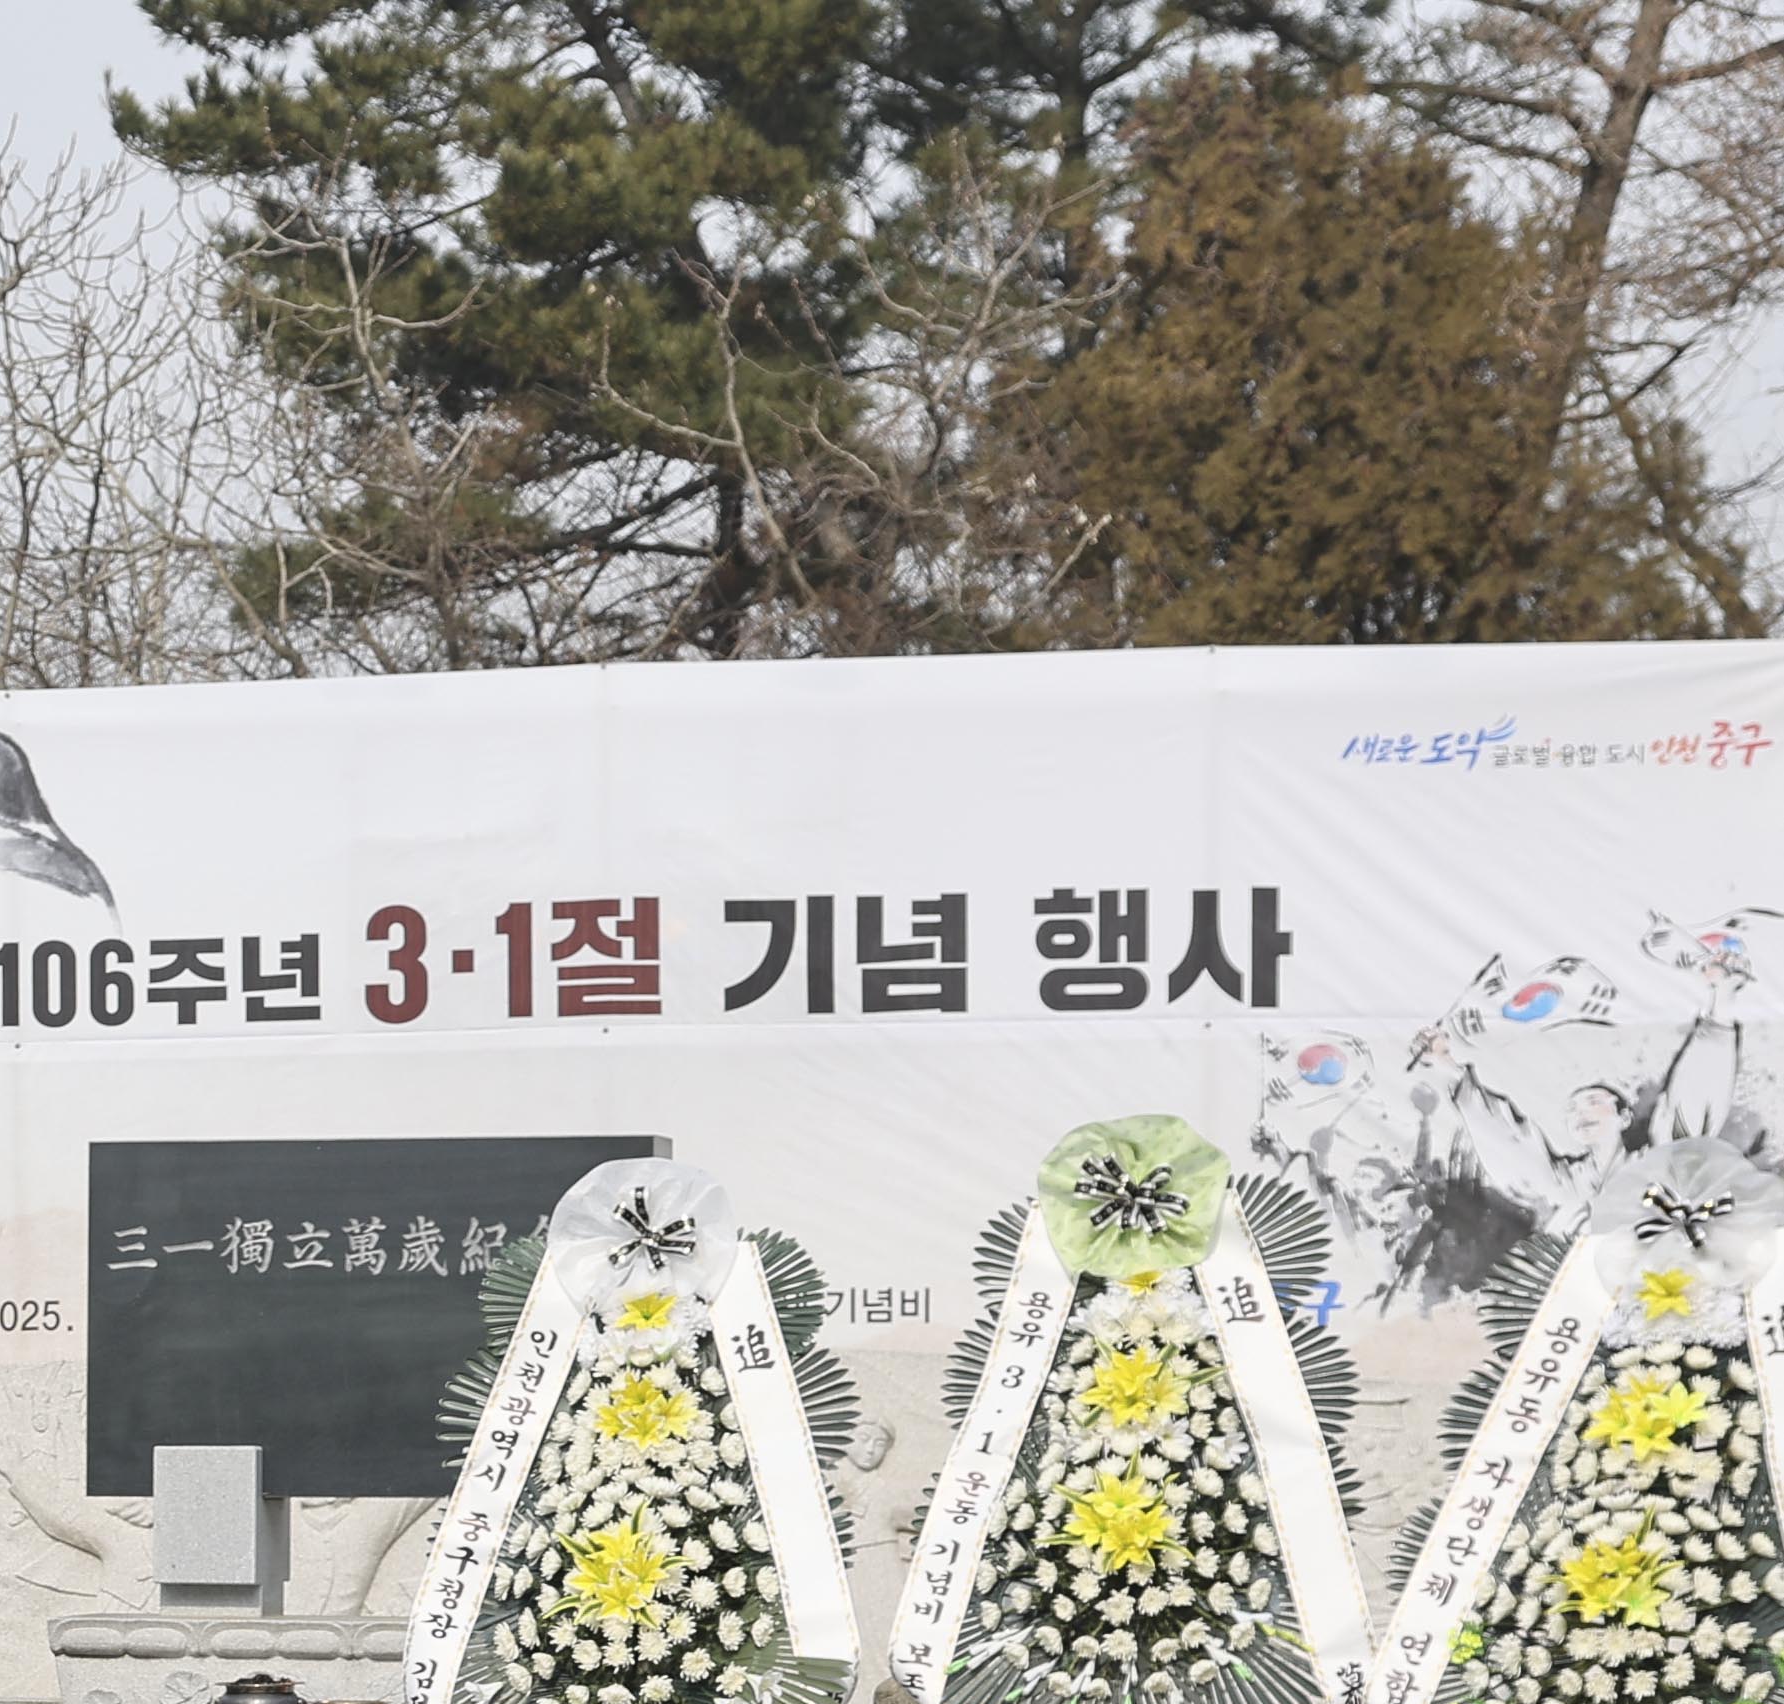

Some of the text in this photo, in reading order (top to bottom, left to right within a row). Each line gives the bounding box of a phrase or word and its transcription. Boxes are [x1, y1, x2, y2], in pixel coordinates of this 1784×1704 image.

[1342, 733, 1420, 764] 새로운
[1421, 729, 1493, 769] 도약
[1492, 742, 1552, 768] 글로벌
[1608, 745, 1646, 767] 도시
[1650, 734, 1701, 766] 인천
[1706, 720, 1772, 769] 중구
[722, 890, 970, 1016] 기념
[1032, 884, 1293, 1011] 행사
[826, 1286, 932, 1326] 기념비
[1011, 1291, 1054, 1348] 용유
[472, 1329, 558, 1491] 인천광역시
[1504, 1316, 1581, 1435] 용유동
[423, 1511, 495, 1639] 중구청장
[913, 1539, 962, 1625] 기념비
[1417, 1456, 1513, 1608] 자생단체
